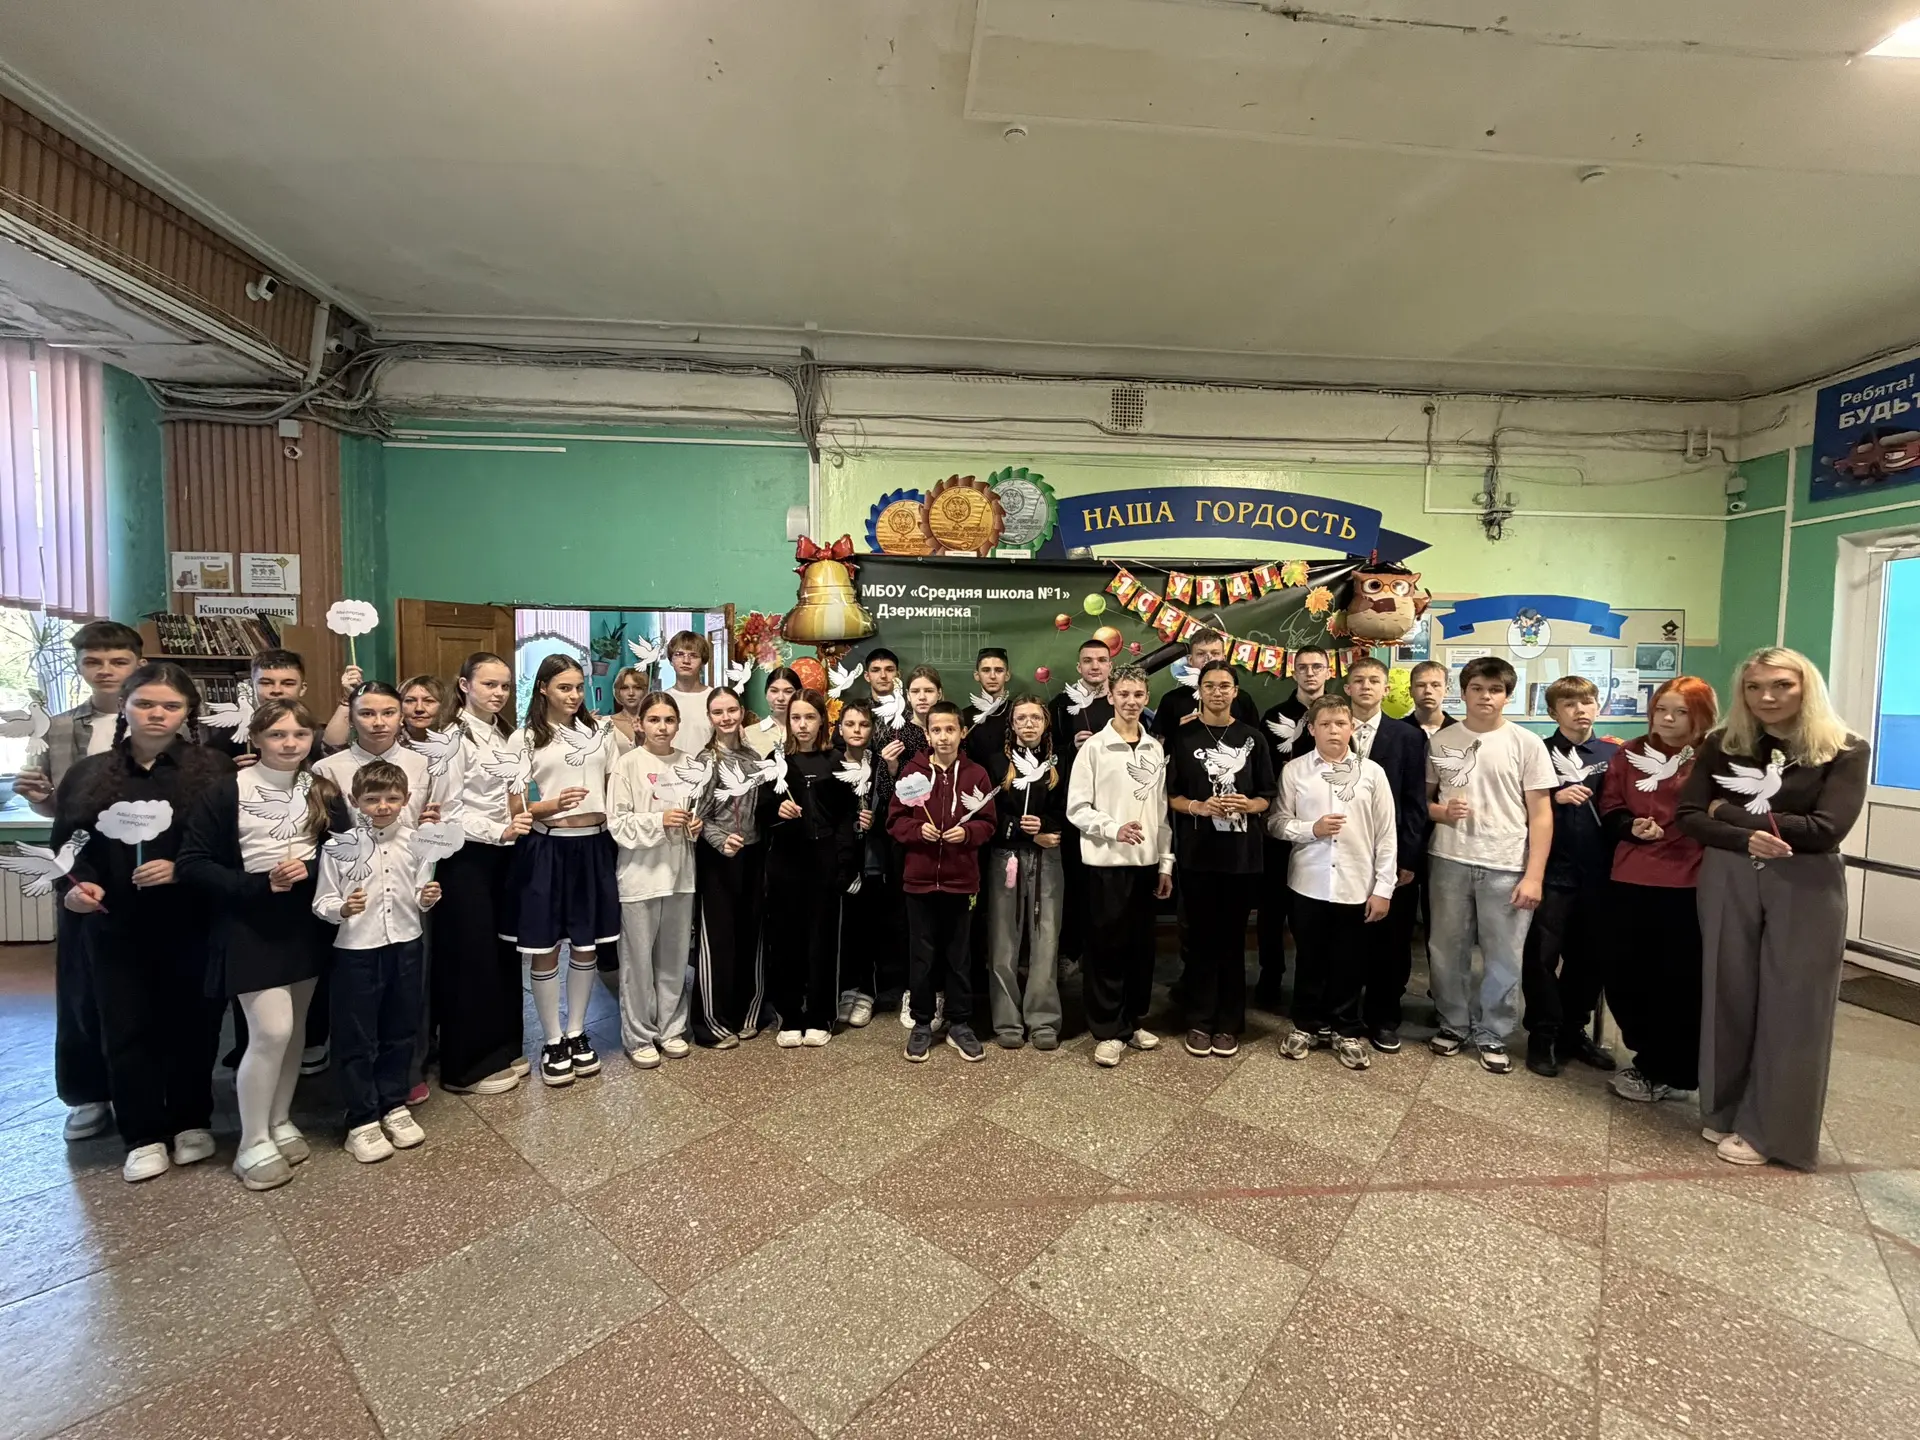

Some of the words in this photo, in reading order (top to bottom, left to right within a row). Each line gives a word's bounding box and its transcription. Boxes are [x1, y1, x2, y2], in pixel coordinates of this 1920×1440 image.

[1840, 373, 1915, 407] Ребята!
[1081, 500, 1175, 532] НАША
[1195, 499, 1357, 541] ГОРДОСТЬ
[861, 584, 906, 598] МБОУ
[910, 584, 982, 601] «Средняя
[986, 587, 1034, 600] школа
[1037, 586, 1071, 600] №1»
[1173, 568, 1272, 599] УРА!
[199, 604, 295, 616] Книгообменник
[876, 603, 972, 619] Дзержинска
